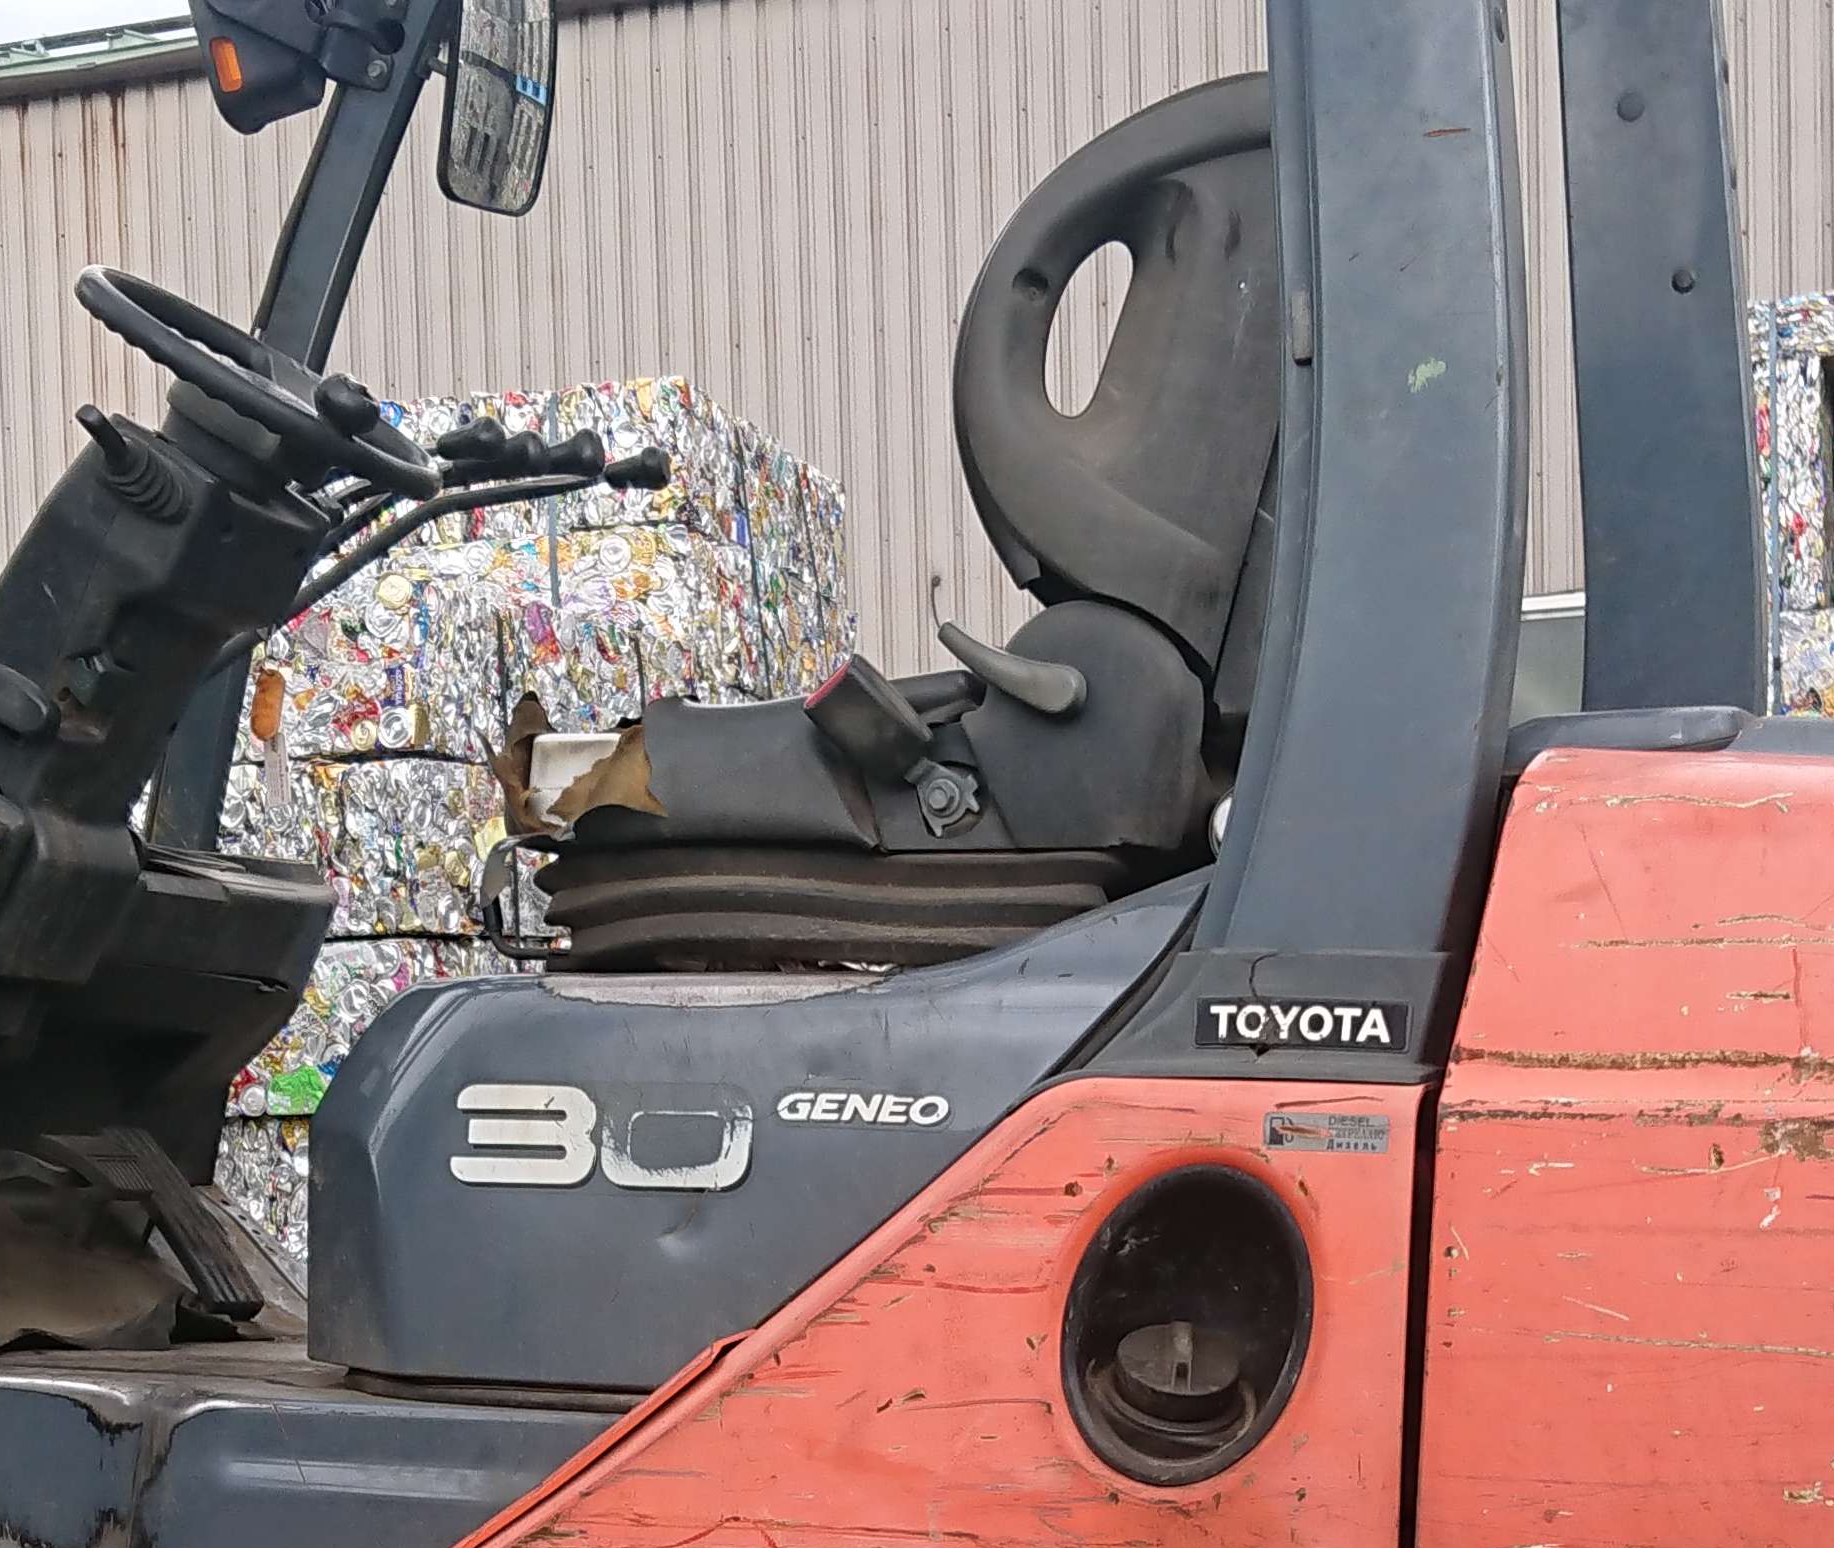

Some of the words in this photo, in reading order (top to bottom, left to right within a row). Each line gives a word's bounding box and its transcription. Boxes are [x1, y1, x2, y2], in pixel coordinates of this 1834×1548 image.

[1209, 1004, 1391, 1043] TOYOTA
[776, 1091, 949, 1126] GENEO
[1328, 1115, 1375, 1127] DIESEL
[450, 1083, 754, 1189] 30
